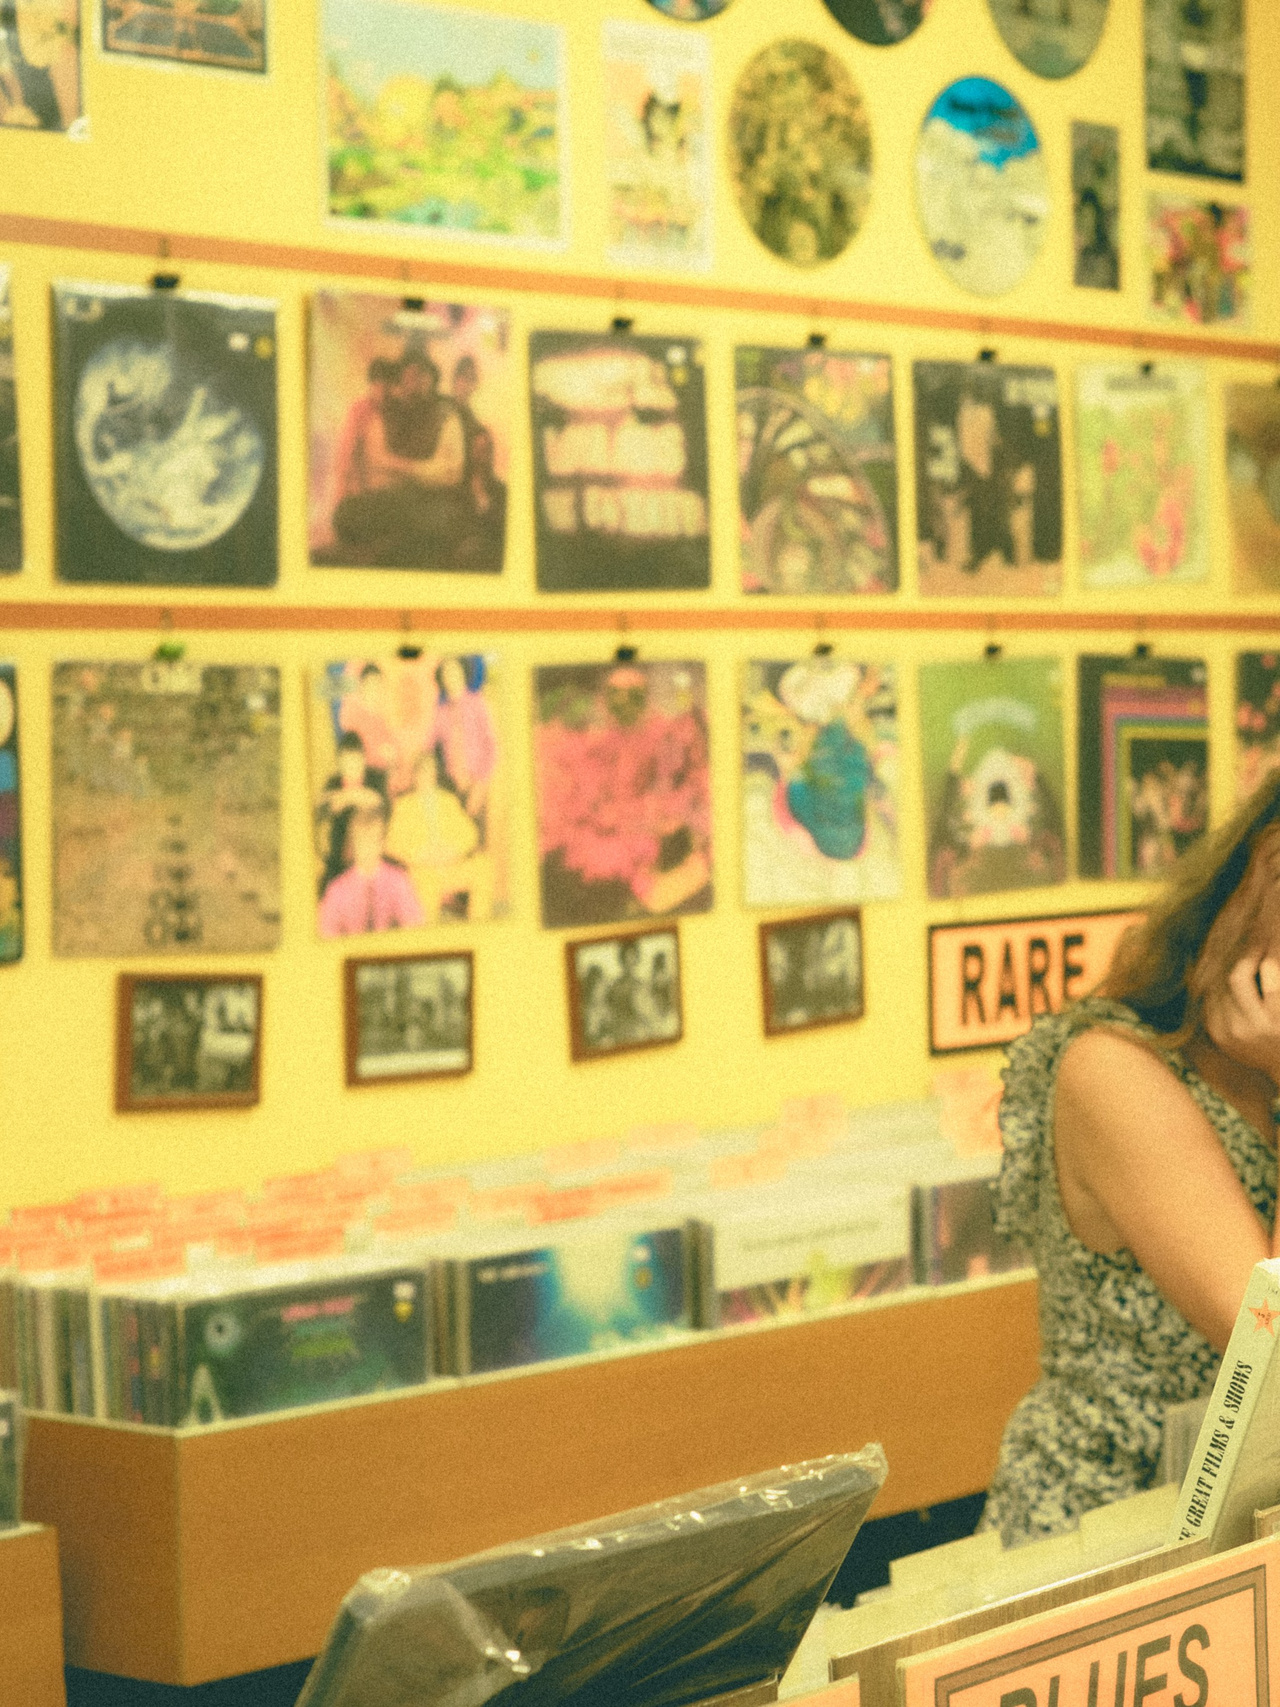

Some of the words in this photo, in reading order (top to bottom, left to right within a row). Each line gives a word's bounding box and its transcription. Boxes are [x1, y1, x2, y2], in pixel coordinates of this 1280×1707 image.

[1223, 1360, 1254, 1414] SHOWS
[1218, 1414, 1236, 1431] &
[1201, 1428, 1230, 1480] FILMS
[1184, 1476, 1214, 1529] GREAT
